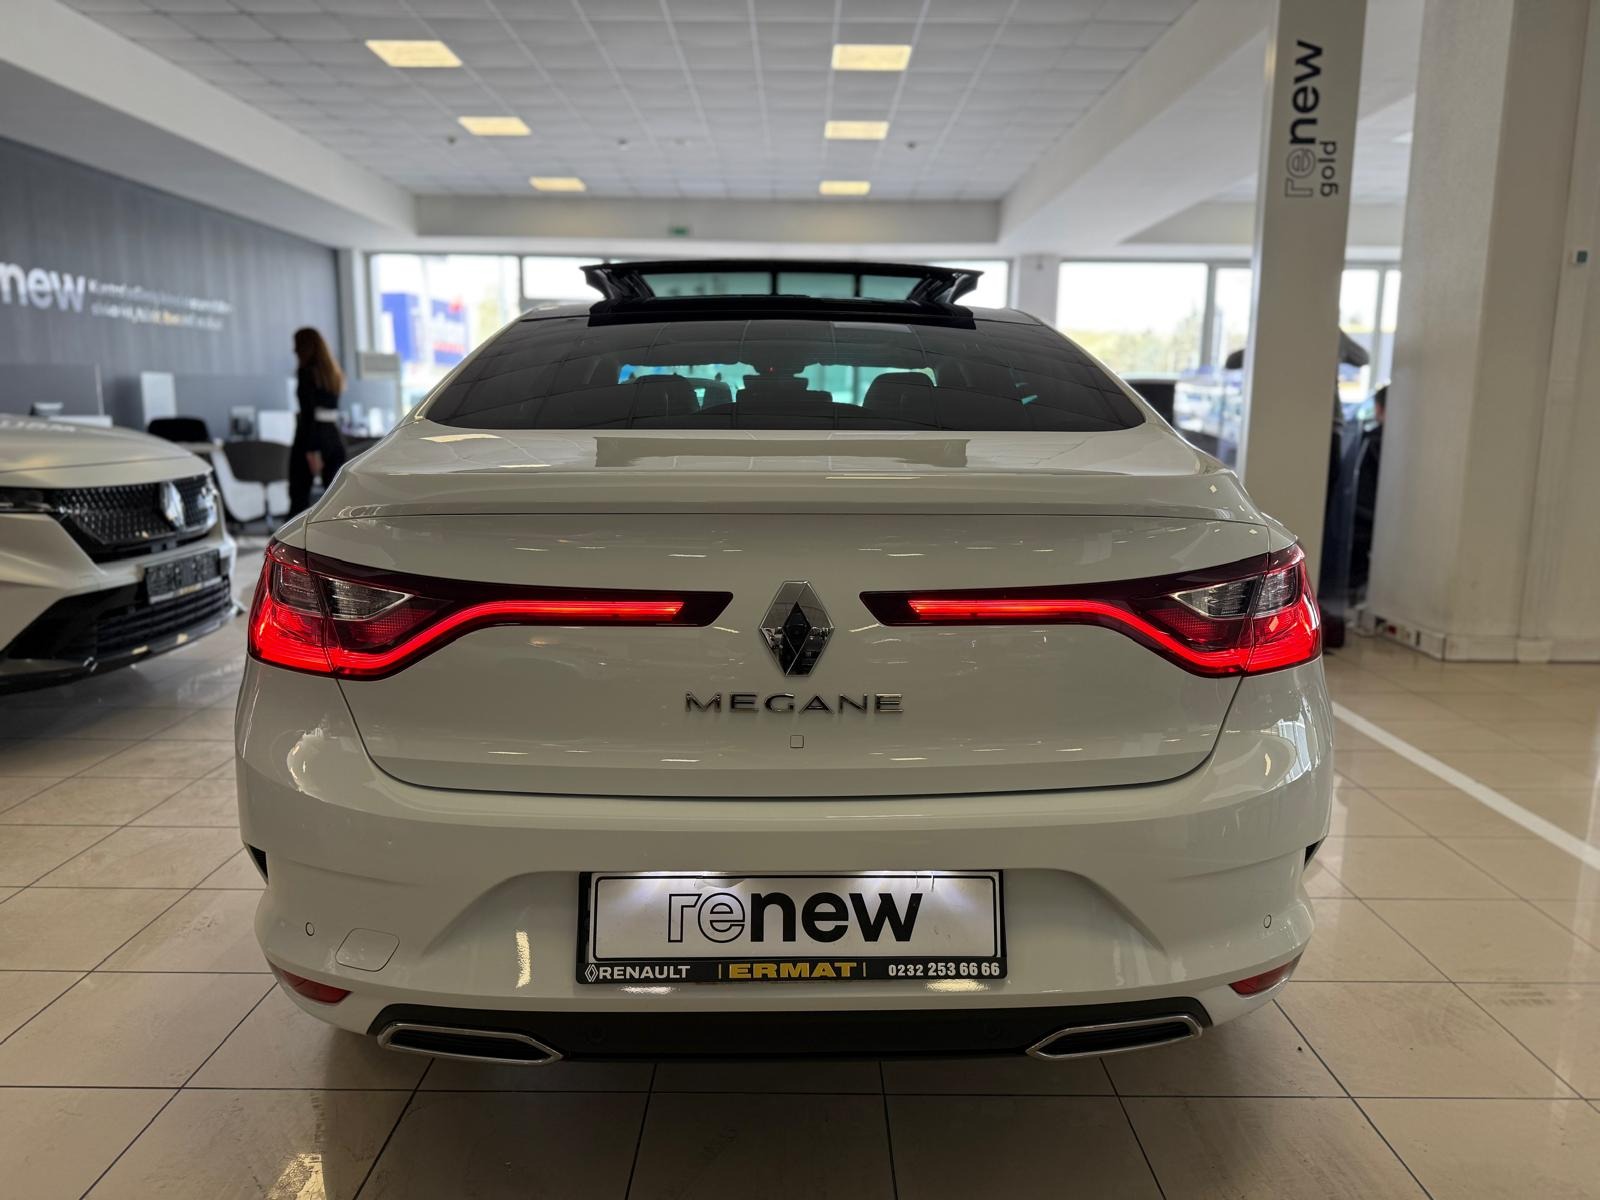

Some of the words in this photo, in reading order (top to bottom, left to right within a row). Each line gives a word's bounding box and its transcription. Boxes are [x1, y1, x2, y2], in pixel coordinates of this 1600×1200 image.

[1285, 39, 1323, 198] renew
[1318, 141, 1339, 197] gold
[685, 692, 904, 714] MEGANE
[668, 892, 923, 943] renew
[599, 965, 691, 980] RENAULT
[729, 962, 857, 979] ERMAT
[888, 964, 924, 976] 0232
[927, 962, 956, 976] 253
